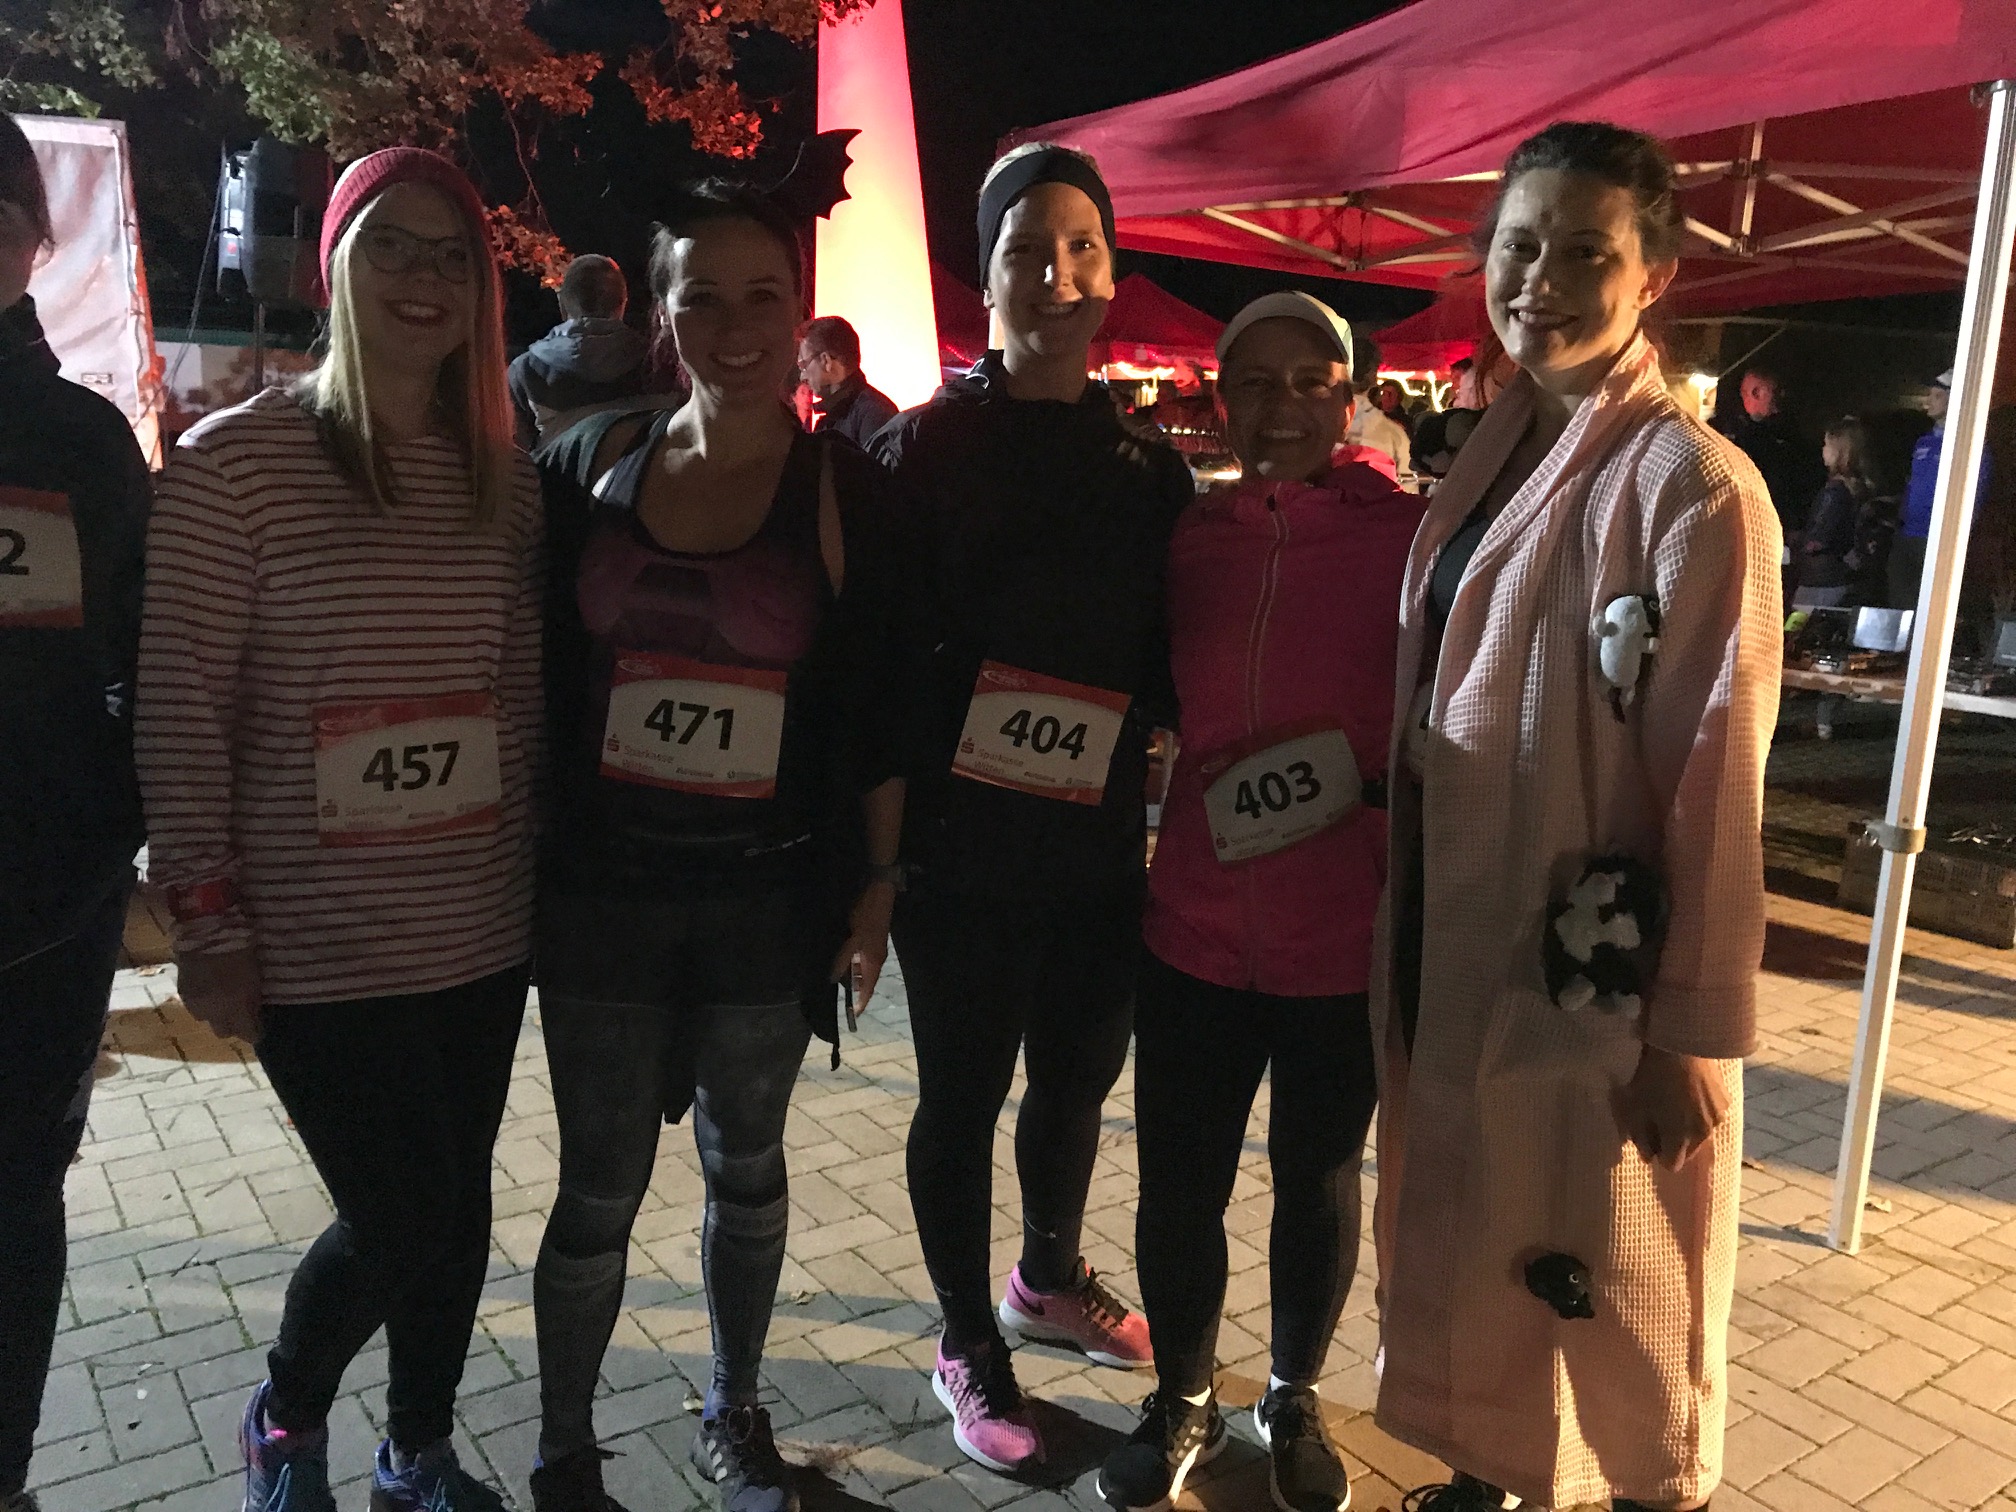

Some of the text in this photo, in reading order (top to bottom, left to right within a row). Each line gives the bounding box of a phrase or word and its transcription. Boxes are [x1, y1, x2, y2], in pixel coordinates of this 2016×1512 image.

[643, 698, 735, 751] 471
[999, 708, 1088, 761] 404
[361, 740, 460, 792] 457
[1234, 760, 1322, 819] 403
